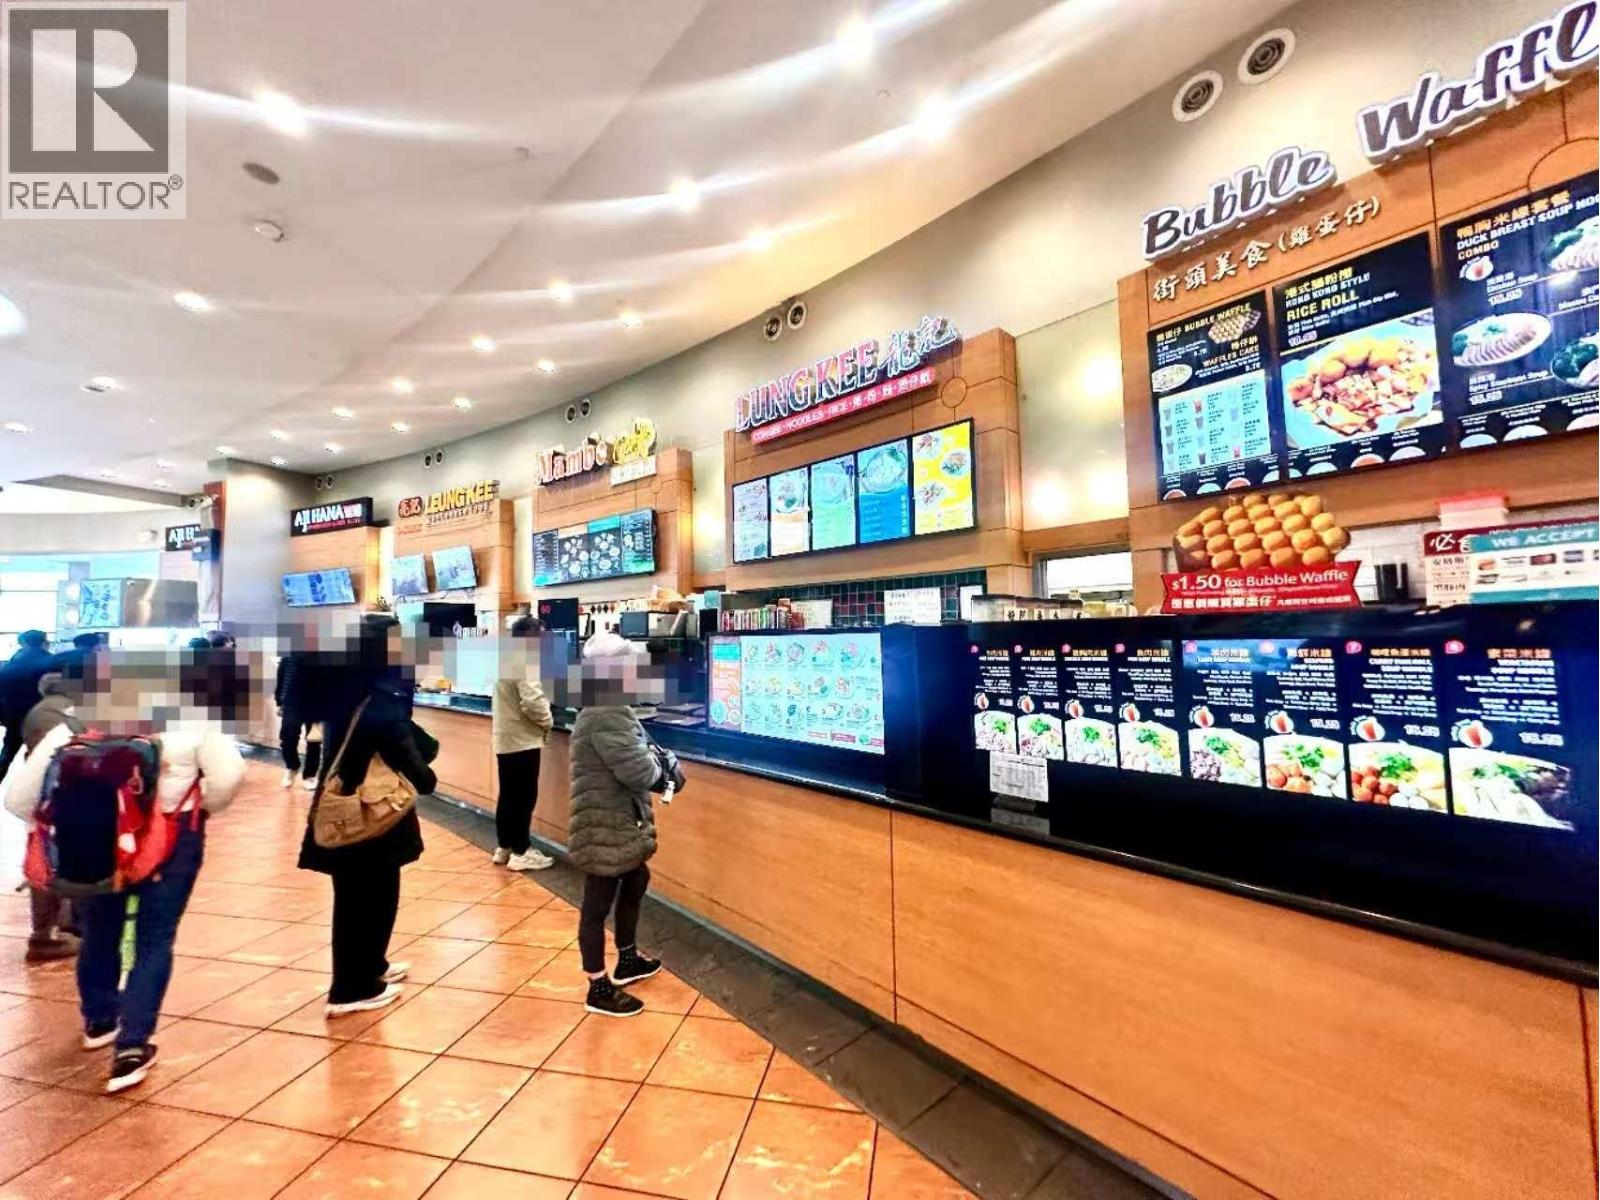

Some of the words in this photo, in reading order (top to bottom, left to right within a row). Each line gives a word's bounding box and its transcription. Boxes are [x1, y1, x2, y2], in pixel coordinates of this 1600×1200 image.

[1144, 147, 1333, 256] Bubble
[1457, 233, 1488, 250] DUCK
[1489, 216, 1537, 239] BREAST
[1538, 203, 1573, 222] SOUP
[1458, 240, 1499, 260] COMBO
[1285, 294, 1310, 308] HONG
[1312, 284, 1338, 300] KONG
[1340, 272, 1370, 290] STYLE
[1184, 315, 1215, 332] BUBBLE
[1217, 302, 1250, 320] WAFFLE
[1287, 302, 1318, 321] RICE
[1321, 290, 1359, 311] ROLL
[1239, 344, 1259, 356] CAKE
[735, 367, 810, 432] LUNG
[814, 338, 877, 406] KEE
[424, 487, 465, 514] LEUNG
[465, 480, 495, 505] KEE
[294, 509, 311, 533] AJI
[311, 504, 345, 523] HANA
[1491, 536, 1520, 547] WE
[1523, 529, 1595, 546] ACCEPT
[1172, 574, 1221, 591] $1.50
[1224, 576, 1243, 588] for
[1246, 573, 1297, 587] Bubble
[1299, 569, 1349, 584] Waffle
